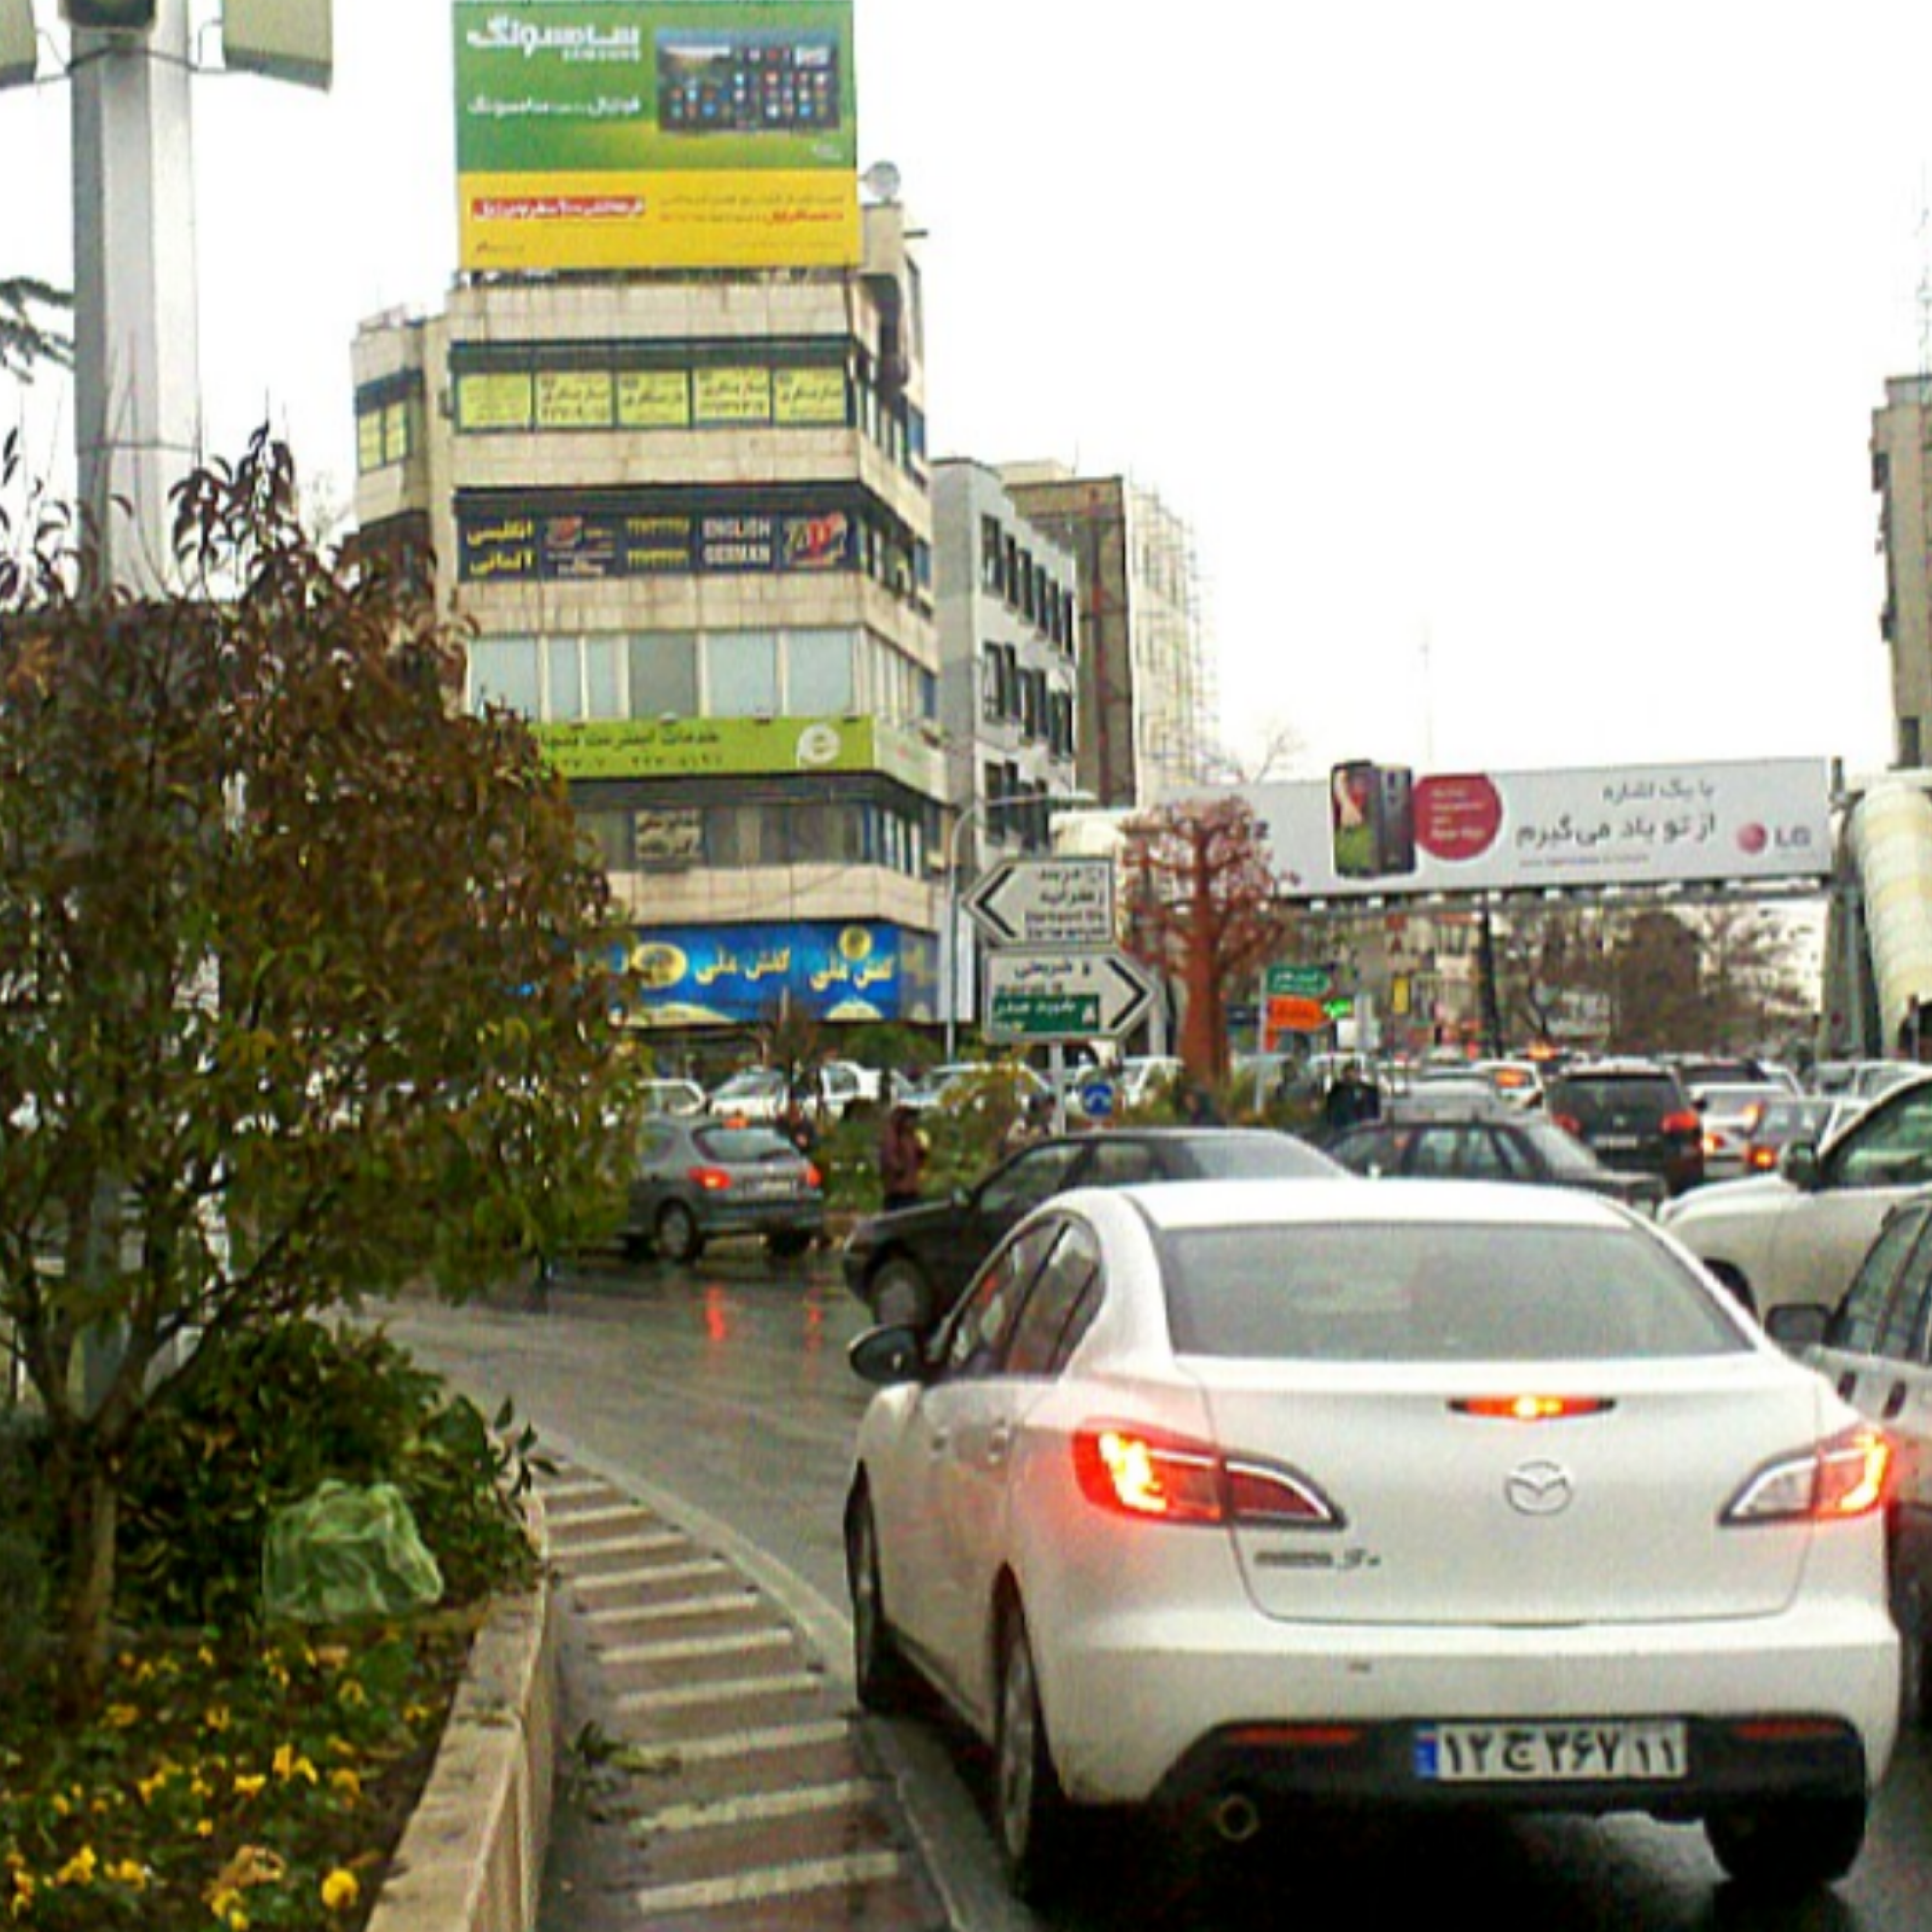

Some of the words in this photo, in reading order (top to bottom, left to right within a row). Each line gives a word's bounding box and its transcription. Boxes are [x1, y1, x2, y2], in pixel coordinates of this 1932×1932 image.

[466, 14, 639, 58] سامسونگ
[703, 518, 770, 538] ENGLISH
[1602, 781, 1654, 804] اشاره
[1660, 779, 1688, 799] یک
[1622, 815, 1656, 844] یاد
[1662, 815, 1689, 842] تو
[1698, 812, 1716, 842] از
[1774, 826, 1811, 847] LG
